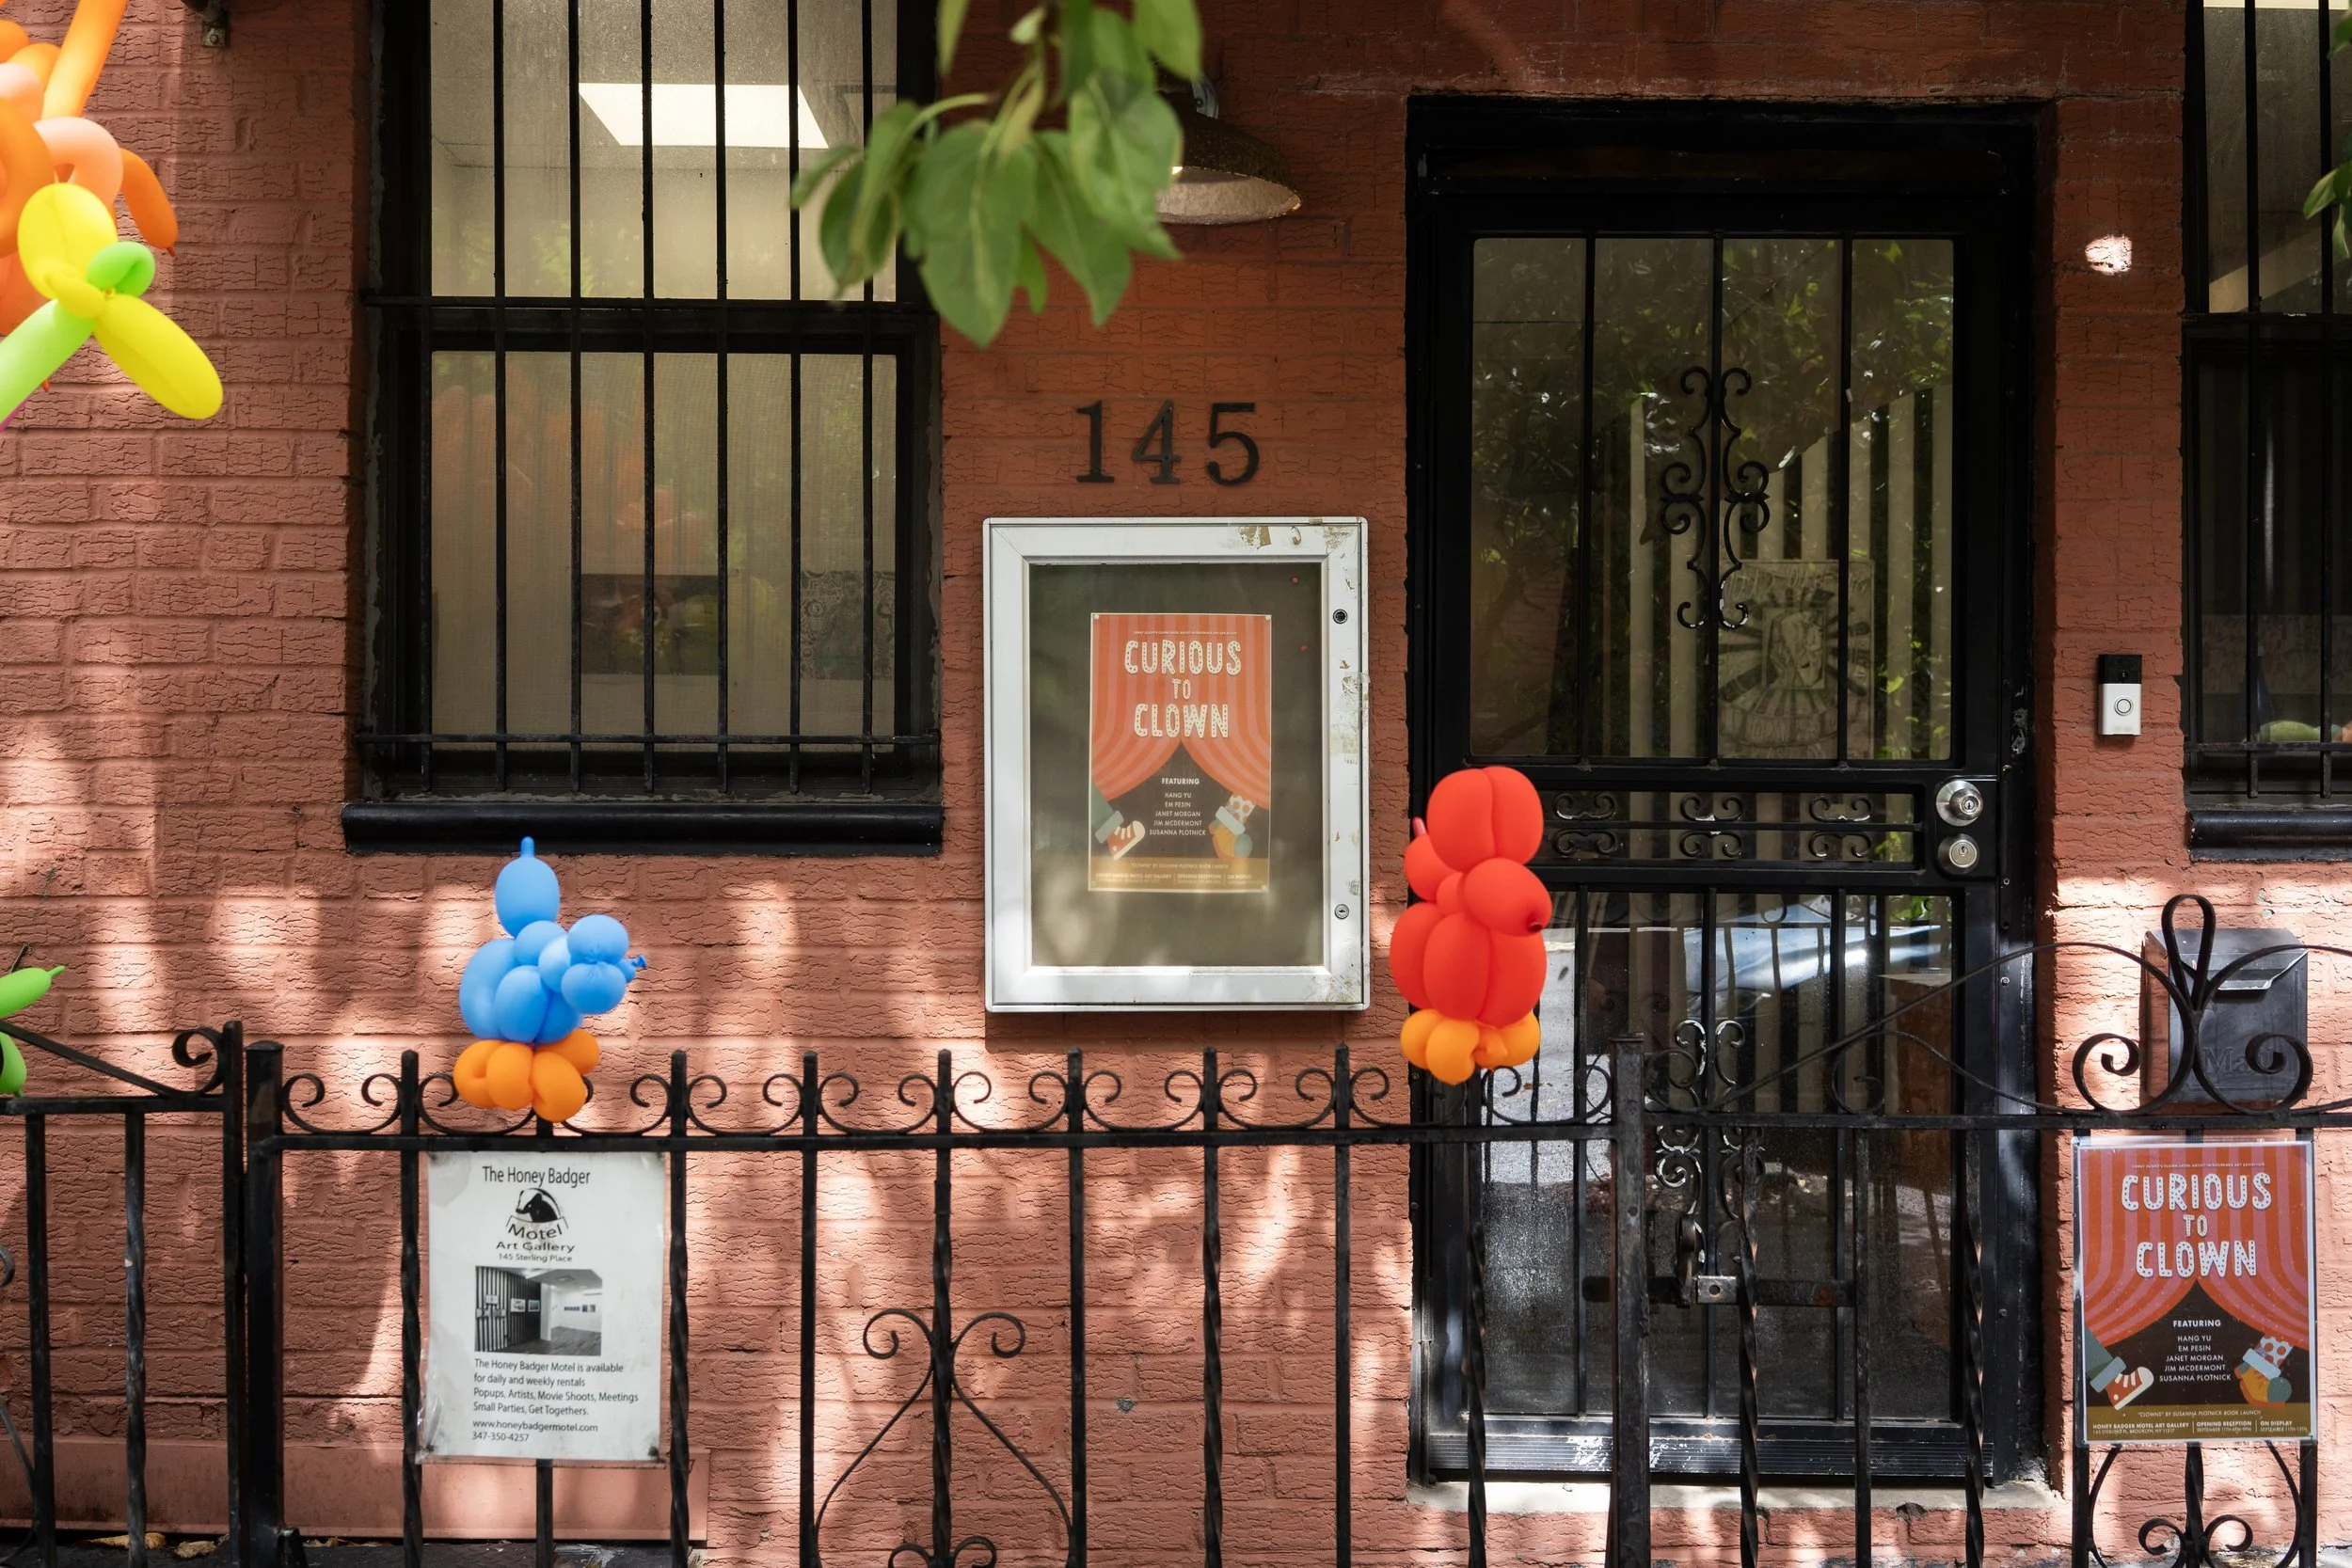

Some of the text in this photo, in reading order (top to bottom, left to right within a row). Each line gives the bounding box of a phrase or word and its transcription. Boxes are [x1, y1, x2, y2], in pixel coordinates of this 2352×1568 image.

[1076, 400, 1259, 486] 145
[1124, 640, 1241, 675] CURIOUS
[1172, 679, 1191, 699] TO
[1134, 704, 1229, 737] CLOWN
[483, 1165, 591, 1188] The Honey Badger
[2122, 1173, 2271, 1211] CURIOUS
[508, 1224, 563, 1240] Motel
[2184, 1214, 2208, 1237] TO
[497, 1241, 575, 1253] Art Gallery
[516, 1254, 548, 1262] Sterling
[2137, 1241, 2257, 1277] CLOWN
[475, 1358, 624, 1372] The Honey Badger Motel is available
[474, 1373, 585, 1387] for daily and weekly rentals
[474, 1387, 638, 1403] Popups, Artists, Movie Shoots, Meetings
[474, 1402, 589, 1417] Small Parties, Get Togethers.
[473, 1420, 597, 1432] www.honeybadgermotel.com
[472, 1432, 529, 1442] 347-350-4257
